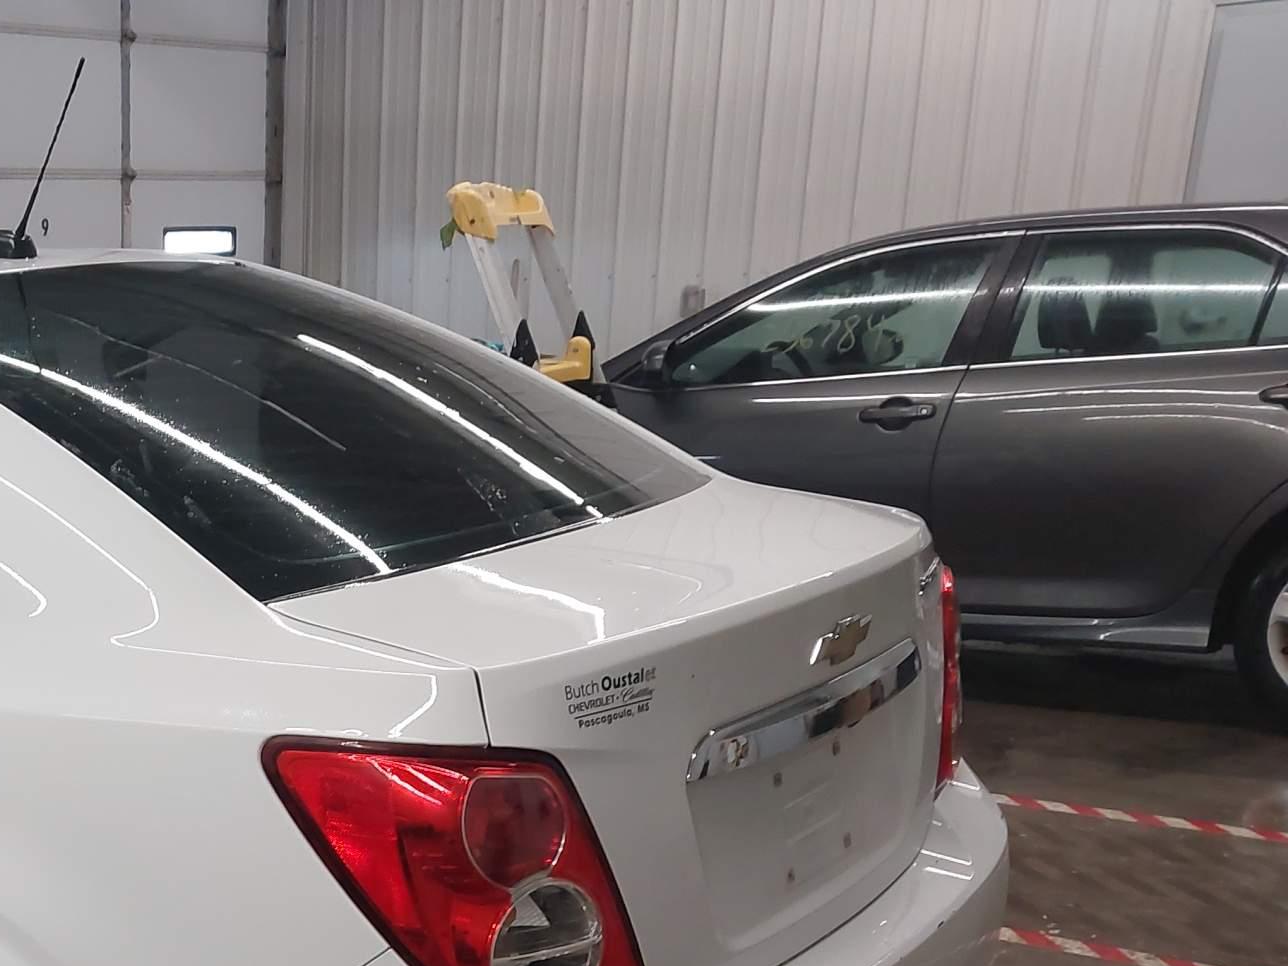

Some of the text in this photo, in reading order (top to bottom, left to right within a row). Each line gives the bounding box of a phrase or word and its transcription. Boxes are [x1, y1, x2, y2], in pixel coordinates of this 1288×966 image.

[41, 217, 49, 237] 9
[564, 680, 600, 701] Butch
[601, 667, 657, 691] Oustalet
[568, 694, 616, 715] CHEVROLET
[637, 702, 650, 713] MS
